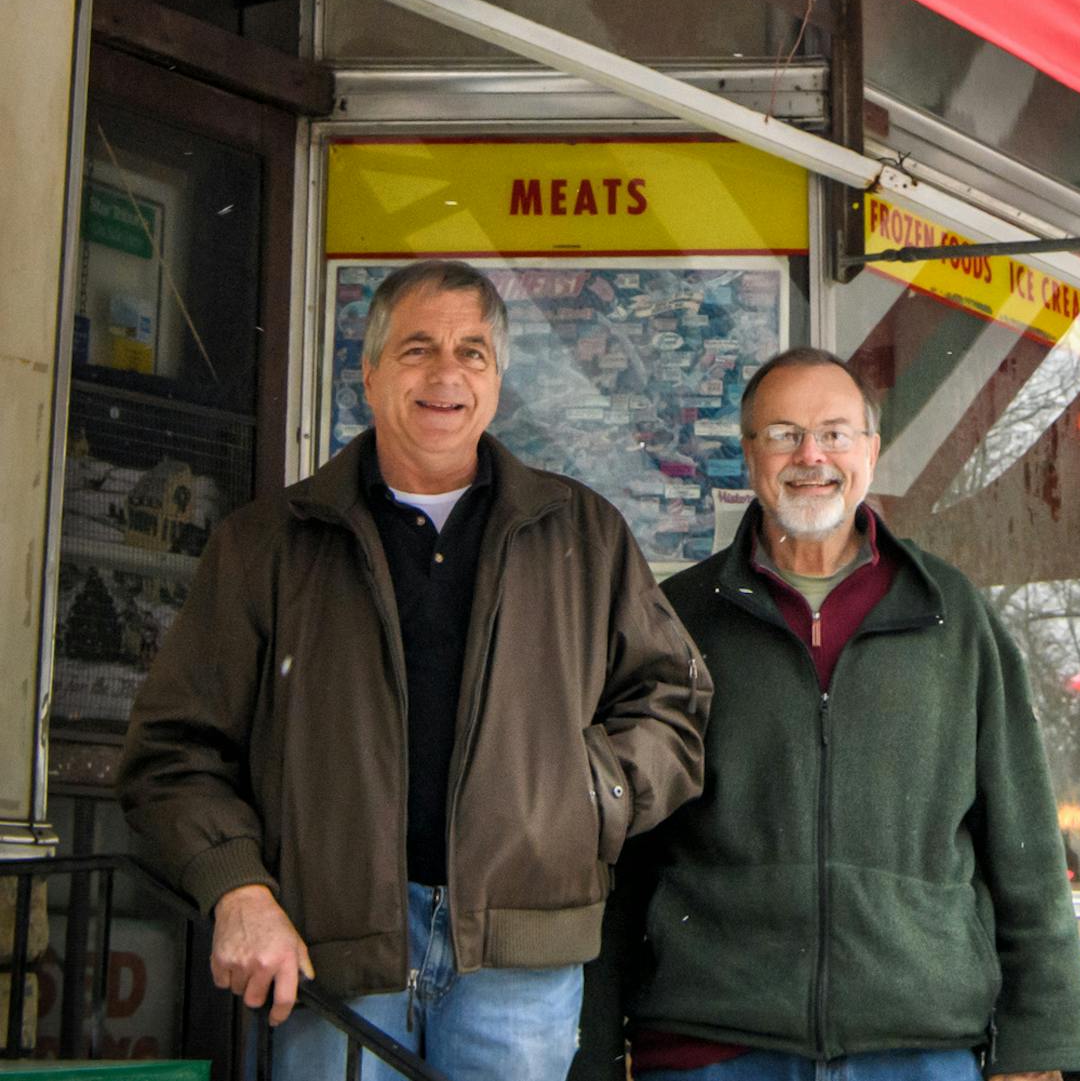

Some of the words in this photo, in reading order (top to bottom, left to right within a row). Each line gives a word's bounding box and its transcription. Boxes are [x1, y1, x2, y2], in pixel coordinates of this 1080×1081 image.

[509, 178, 648, 216] MEATS
[870, 199, 934, 249] FROZEN
[941, 231, 992, 284] FOODS
[1009, 261, 1035, 302] ICE
